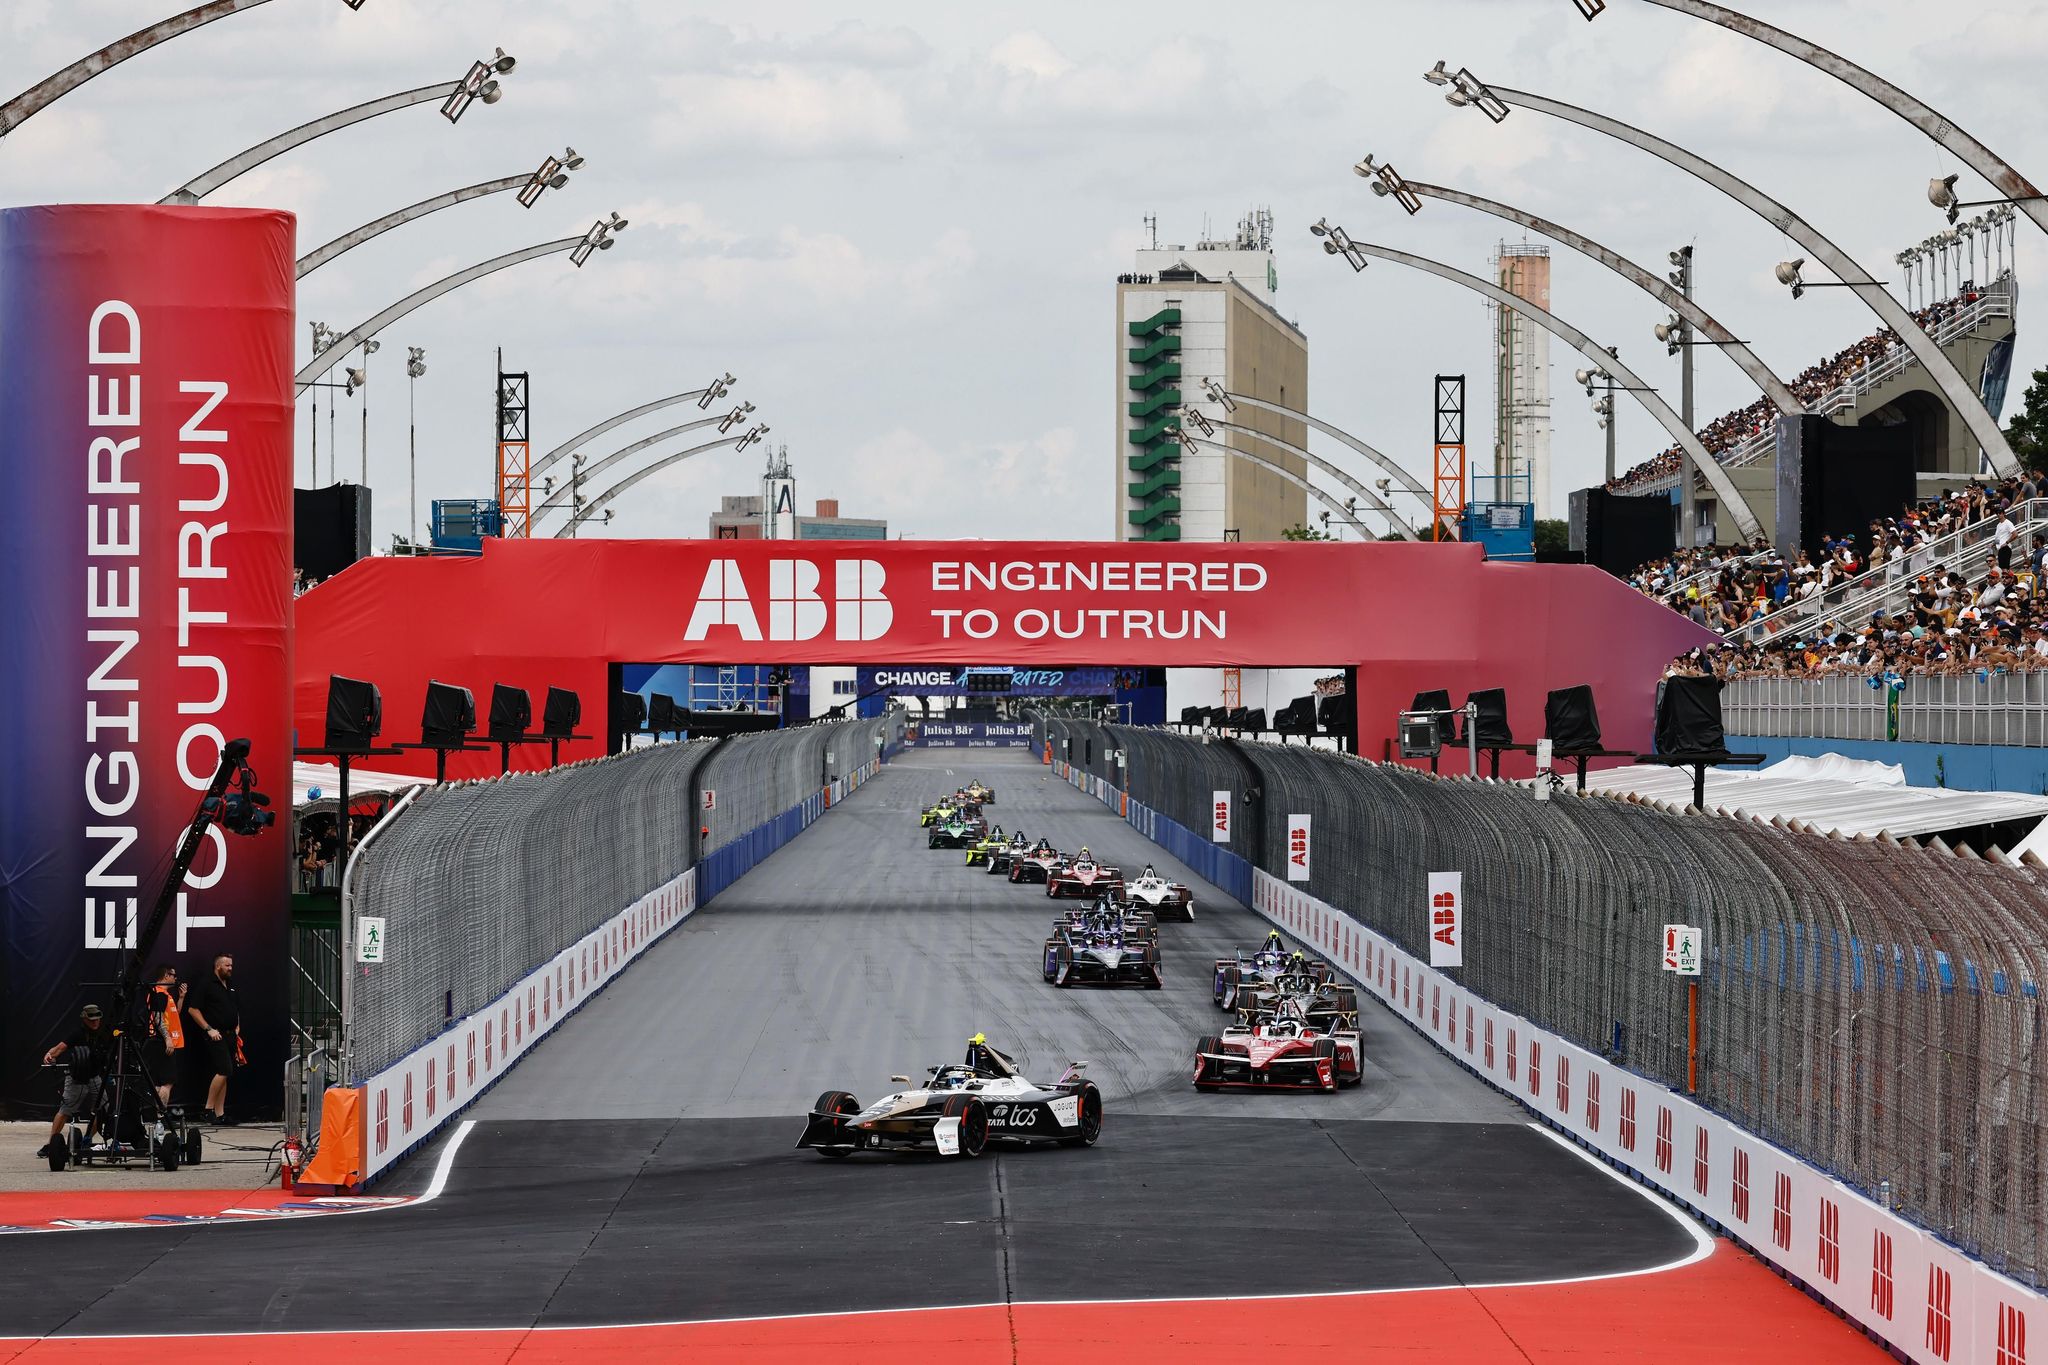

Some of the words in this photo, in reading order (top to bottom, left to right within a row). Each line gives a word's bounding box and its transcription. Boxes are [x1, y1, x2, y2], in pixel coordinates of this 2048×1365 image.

[176, 380, 230, 791] OUTRUN
[684, 559, 894, 642] ABB
[931, 561, 1268, 593] ENGINEERED
[85, 299, 141, 950] ENGINEERED
[931, 609, 998, 639] TO
[1014, 609, 1227, 640] OUTRUN
[875, 671, 955, 686] CHANGE.
[924, 725, 953, 736] Julius
[955, 725, 973, 735] Bär
[986, 725, 1015, 736] Julius
[1215, 801, 1227, 831] ABB
[1291, 828, 1307, 867] ABB
[176, 822, 229, 952] TO
[1433, 891, 1455, 946] ABB
[1009, 1104, 1039, 1127] tcs
[1557, 1054, 1569, 1114] ABB
[1586, 1070, 1599, 1133] ABB
[1619, 1087, 1636, 1152] ABB
[1655, 1105, 1672, 1175] ABB
[1693, 1124, 1708, 1197] ABB
[1732, 1147, 1749, 1224] ABB
[1772, 1171, 1791, 1252] ABB
[1818, 1197, 1839, 1285] ABB
[1871, 1228, 1893, 1321] ABB
[1926, 1262, 1952, 1362] ABB
